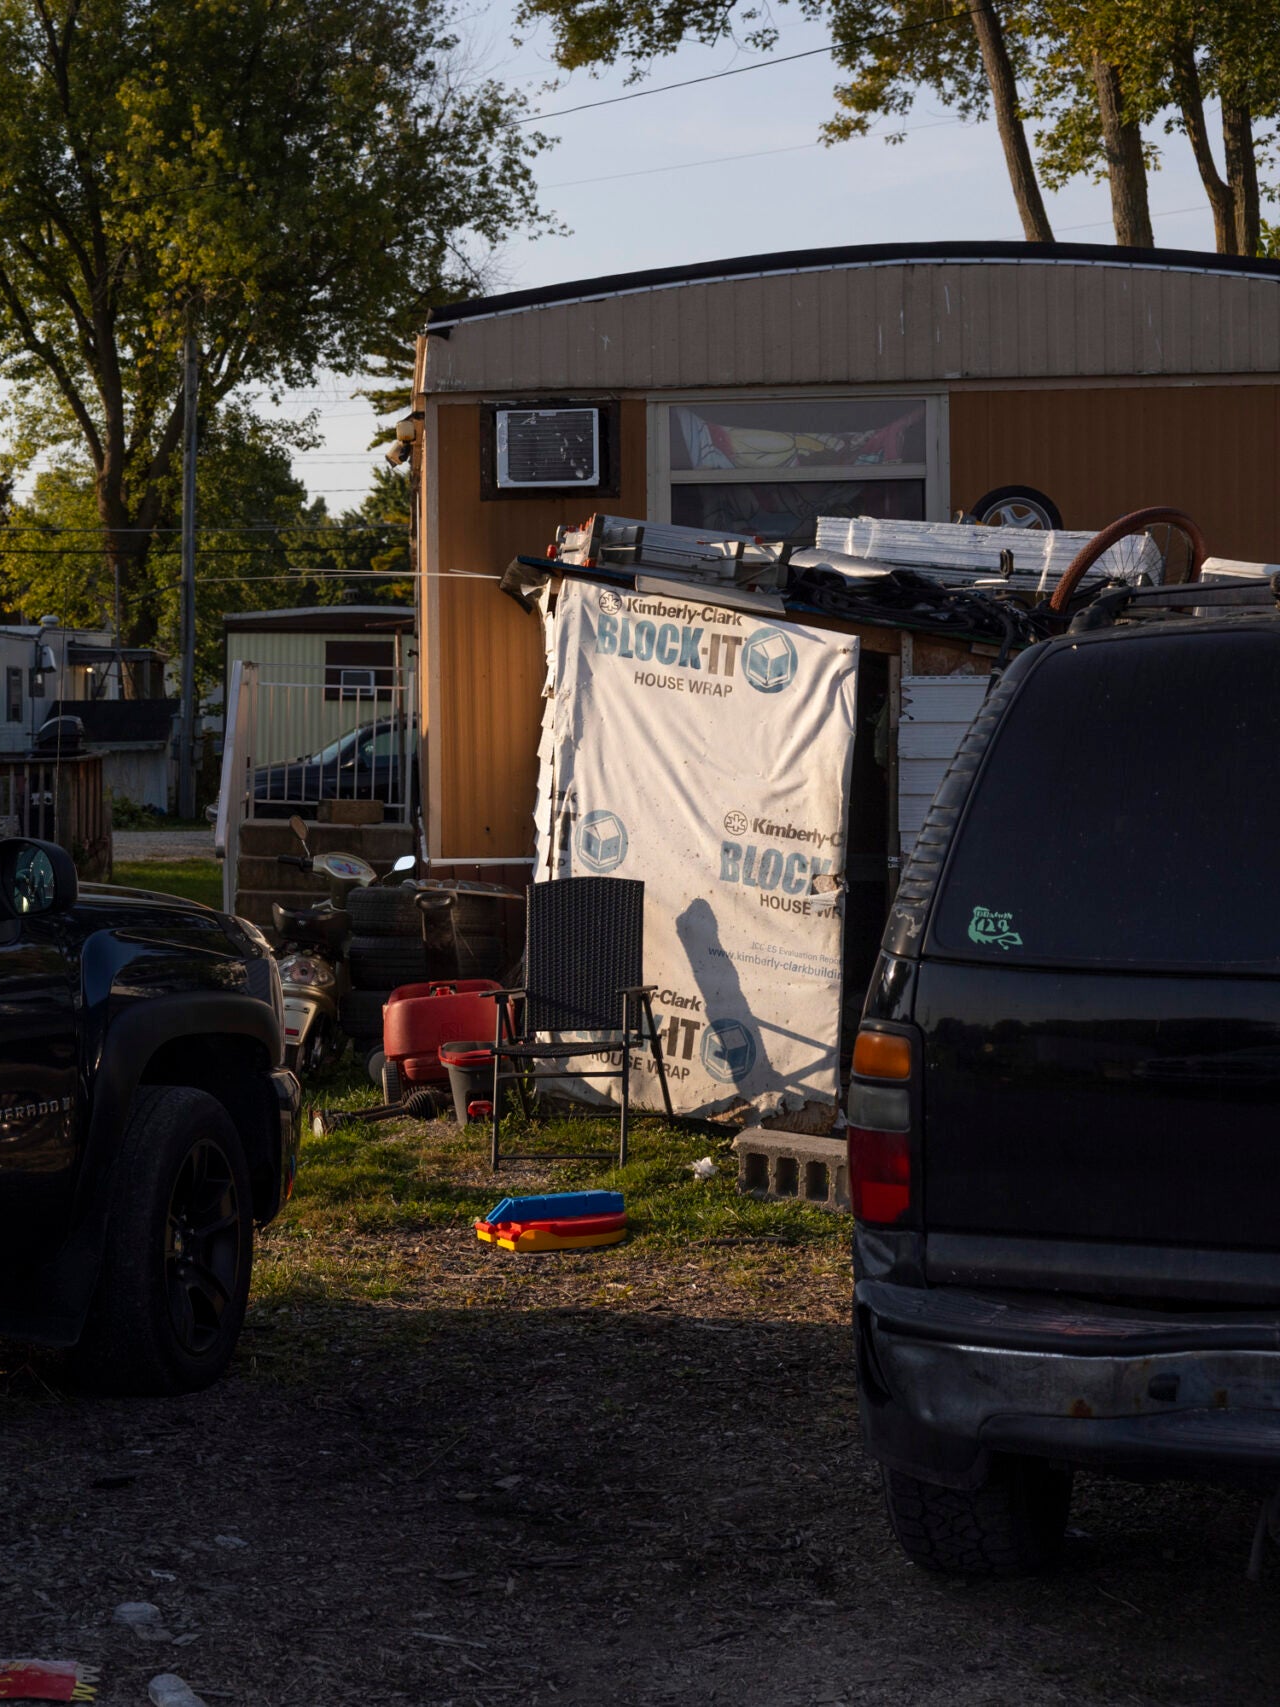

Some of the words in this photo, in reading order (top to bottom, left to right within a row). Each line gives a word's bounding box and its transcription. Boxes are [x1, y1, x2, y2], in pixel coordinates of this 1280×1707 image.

[626, 597, 743, 626] Kimberly-Clark
[595, 613, 743, 678] BLOCK-IT
[634, 671, 685, 692] HOUSE
[688, 679, 733, 698] WRAP
[760, 893, 812, 916] HOUSE
